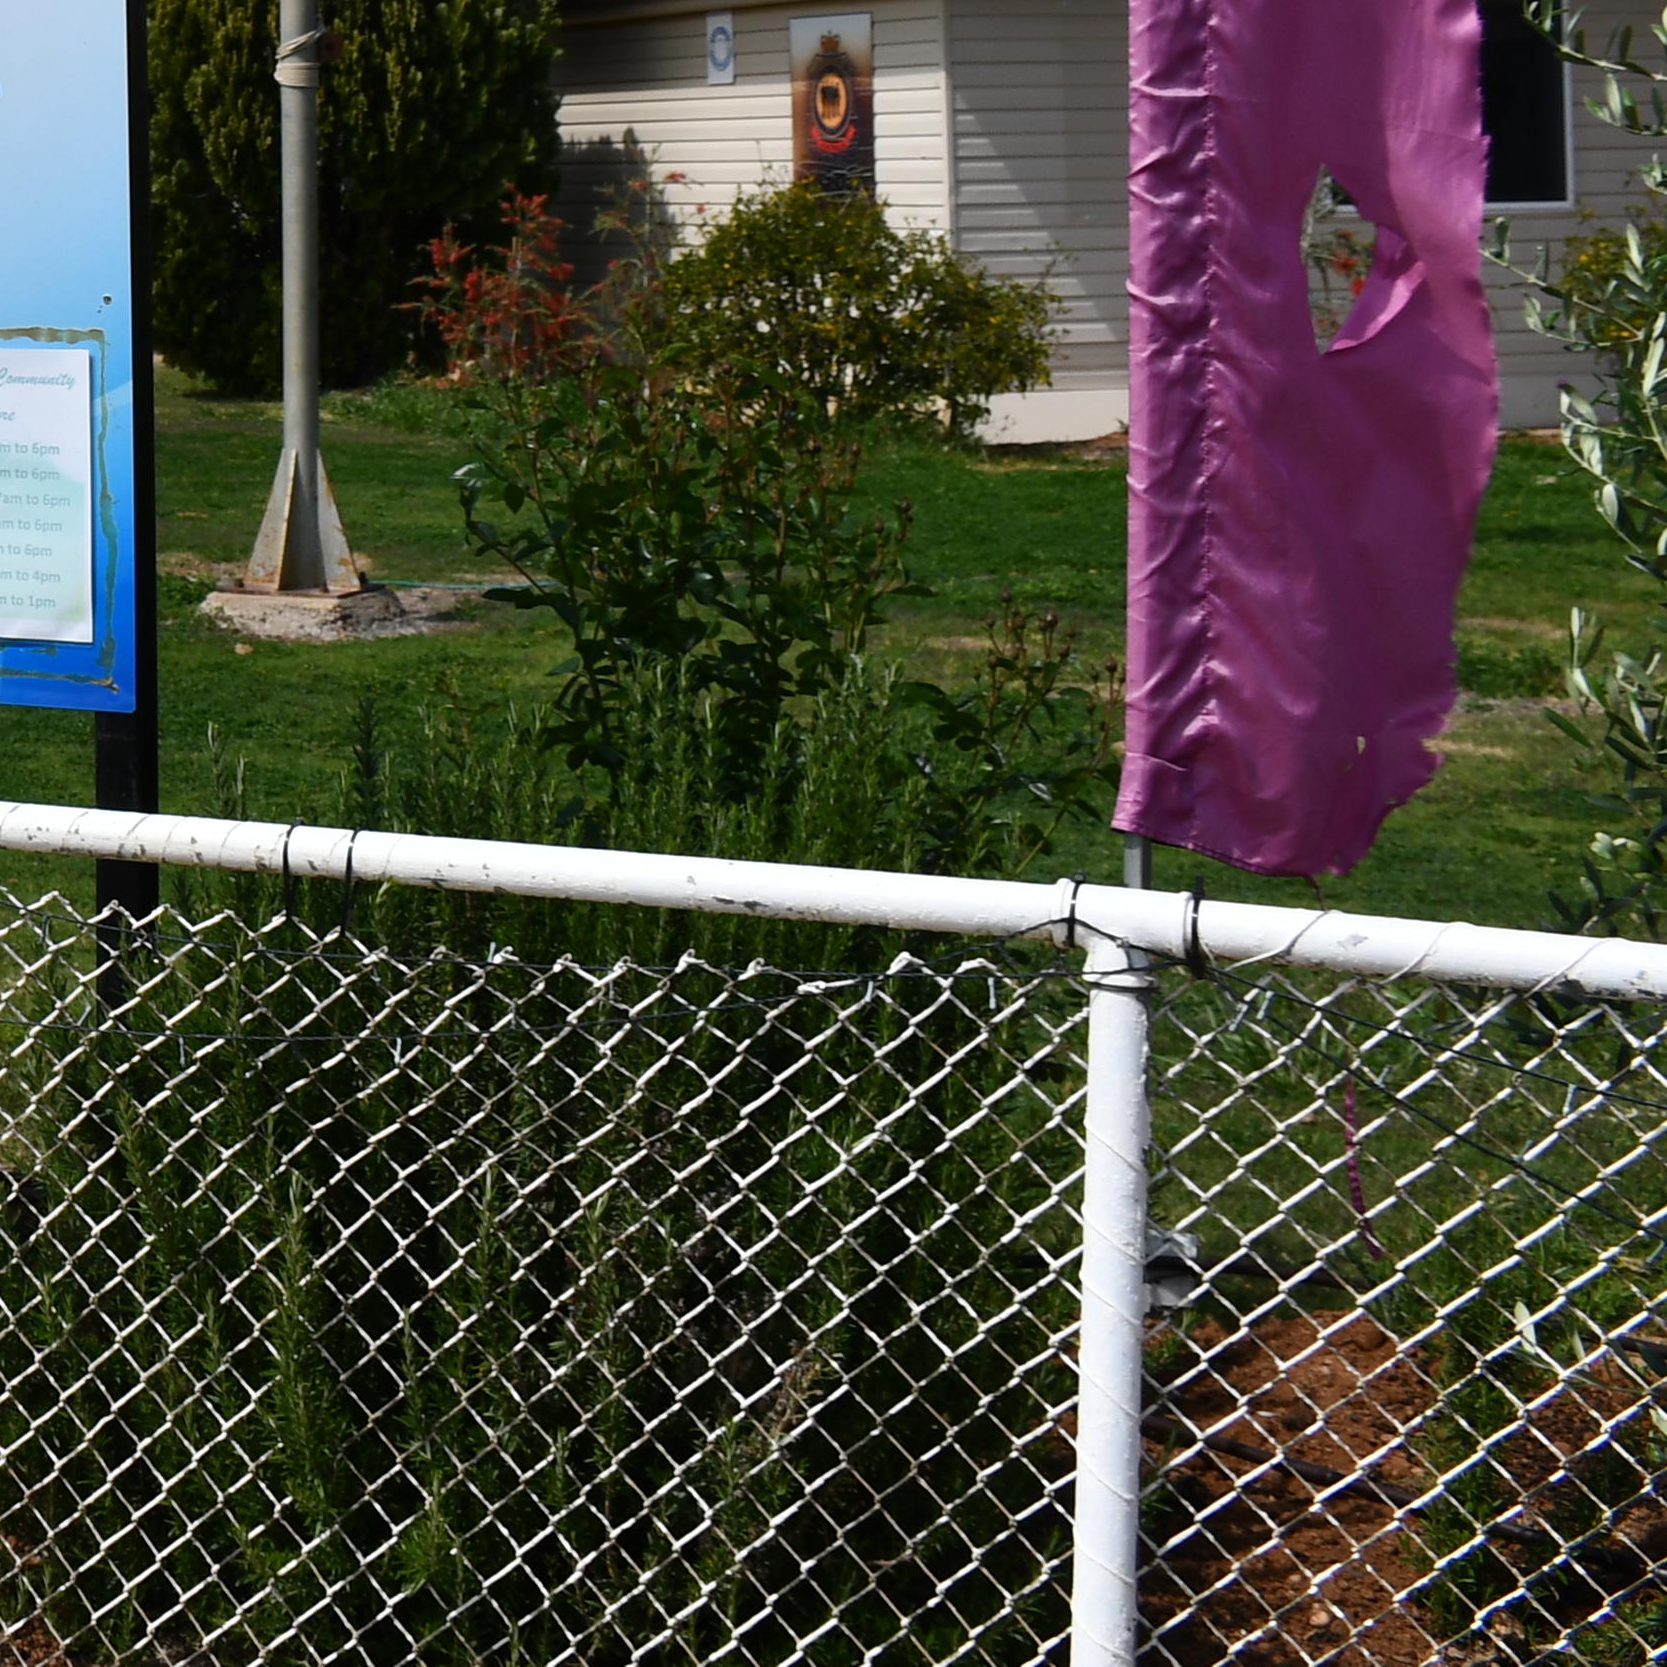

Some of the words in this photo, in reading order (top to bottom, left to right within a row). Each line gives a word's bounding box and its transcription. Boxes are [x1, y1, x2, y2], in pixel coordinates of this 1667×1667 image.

[15, 442, 28, 454] to
[31, 442, 60, 457] 6pm
[15, 467, 28, 479] to
[31, 467, 60, 481] 6pm
[26, 493, 39, 505] to
[42, 494, 71, 508] 6pm
[18, 518, 31, 530] to
[7, 543, 20, 555] to
[16, 569, 29, 581] to
[11, 594, 24, 606] to
